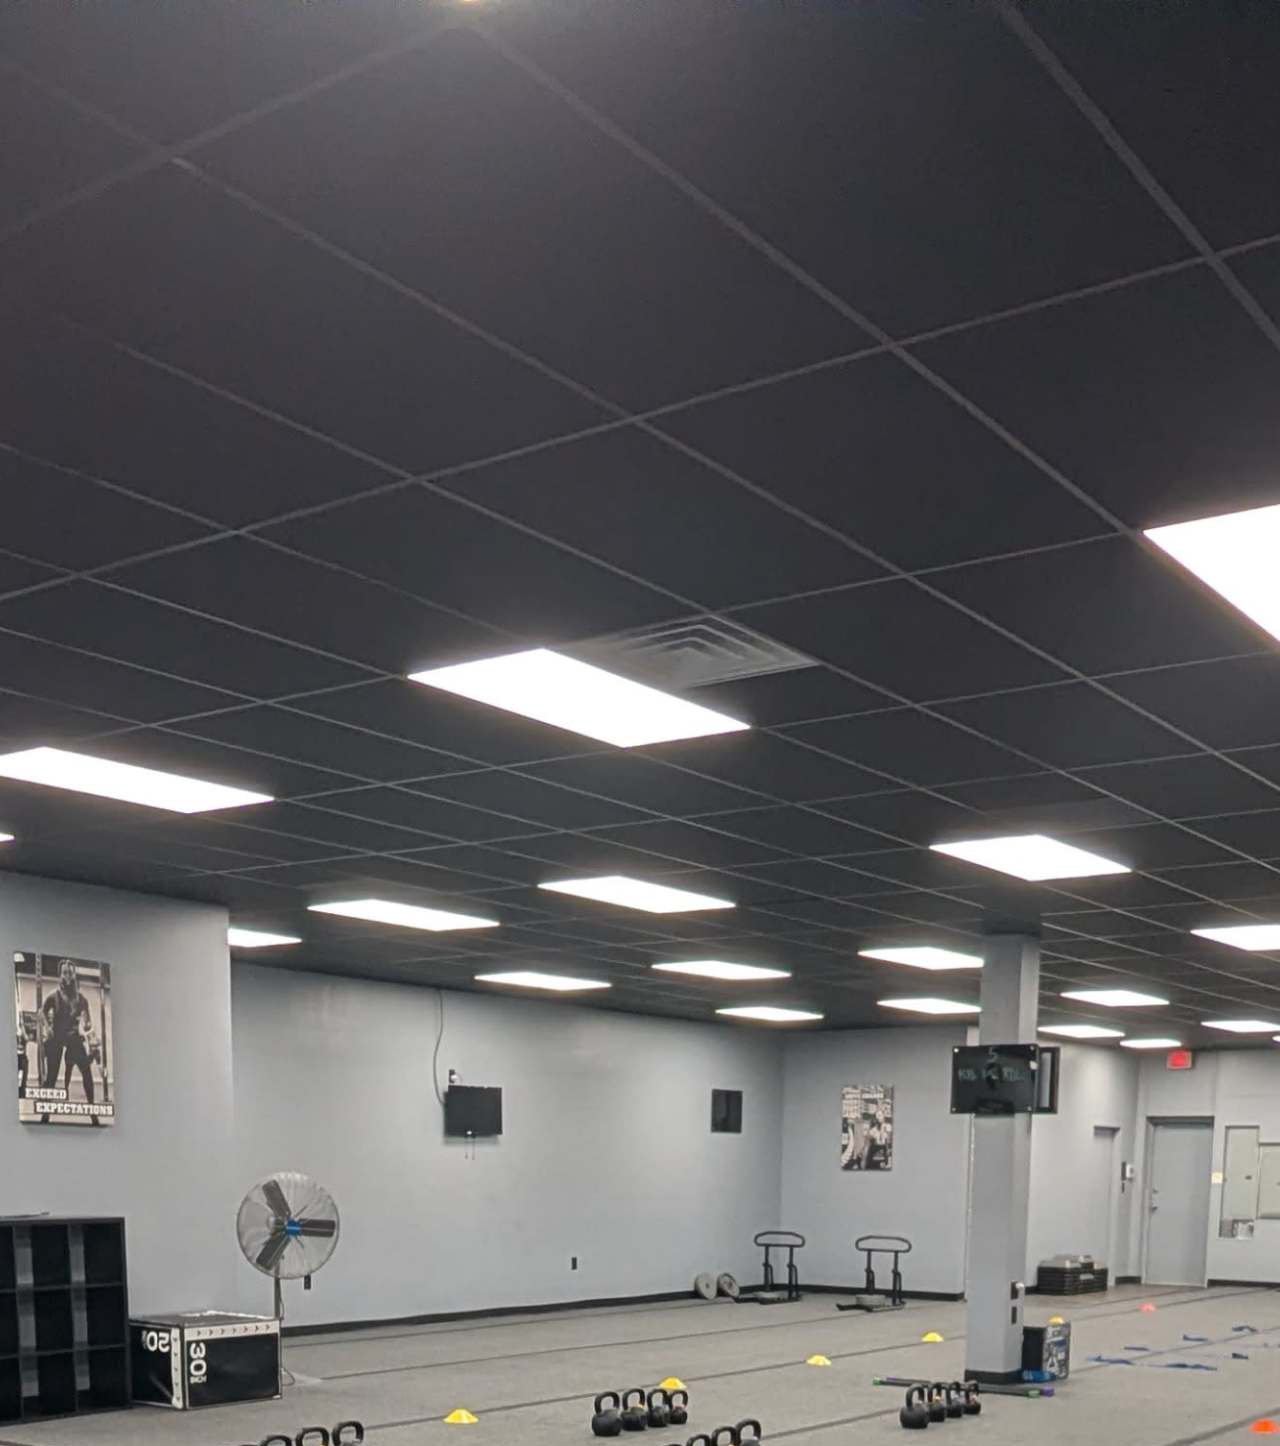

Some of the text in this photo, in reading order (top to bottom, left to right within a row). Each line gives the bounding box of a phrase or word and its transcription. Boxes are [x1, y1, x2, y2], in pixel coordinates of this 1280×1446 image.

[25, 1087, 67, 1099] EXCEED
[36, 1102, 113, 1115] EXPECTATIONS
[190, 1342, 207, 1376] 30
